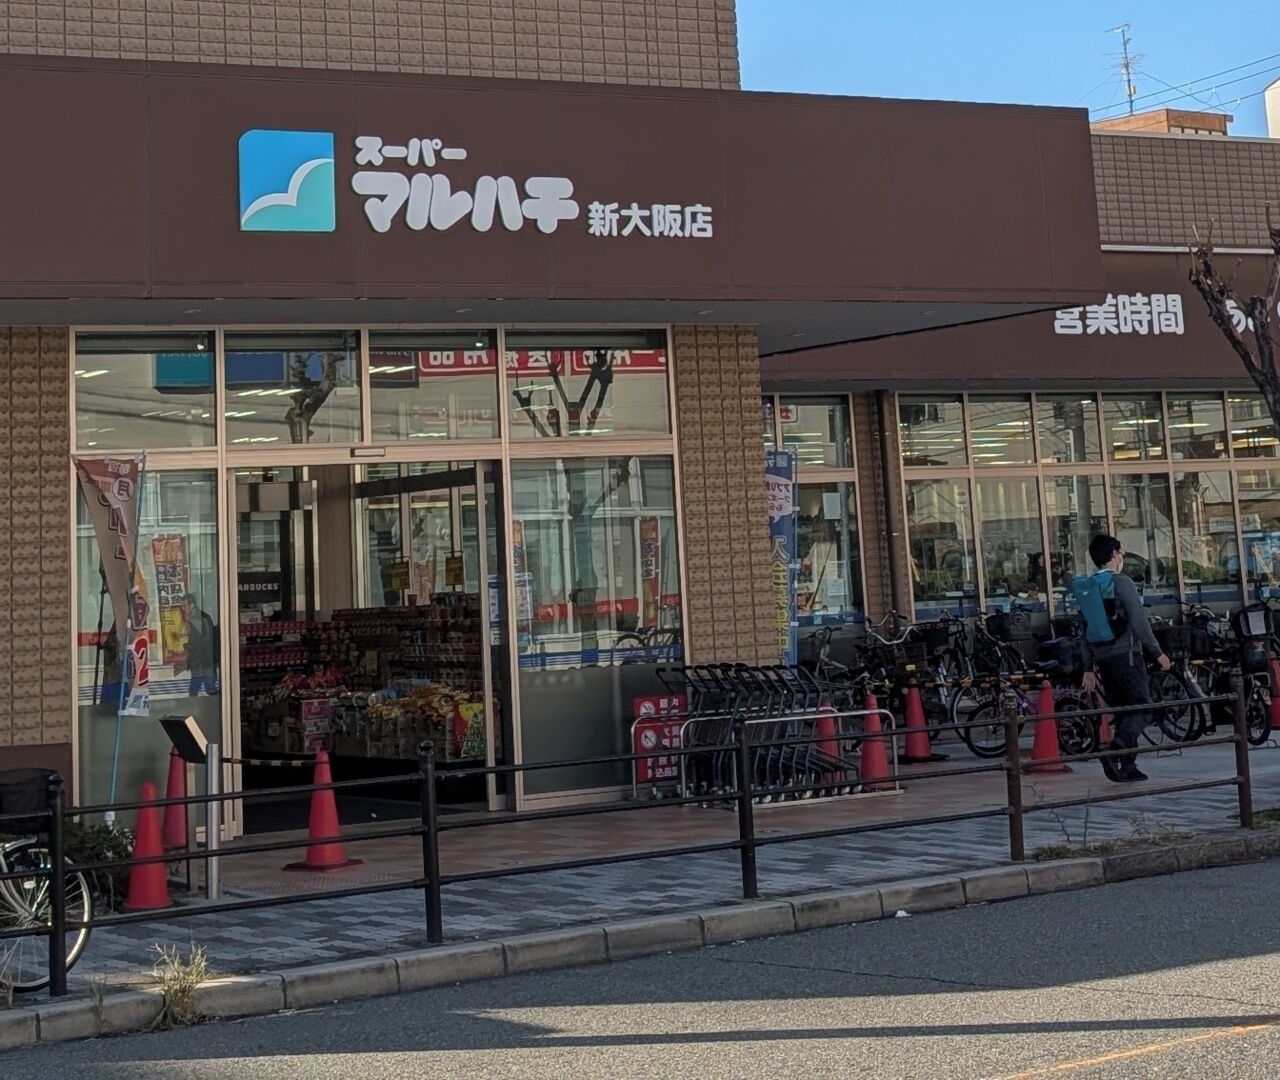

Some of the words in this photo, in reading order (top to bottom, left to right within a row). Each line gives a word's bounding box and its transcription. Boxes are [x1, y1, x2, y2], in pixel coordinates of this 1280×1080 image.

[354, 136, 468, 167] スーパー
[351, 170, 580, 234] マルハチ
[587, 201, 714, 238] 新大阪店
[1054, 293, 1184, 335] 営業時間
[238, 583, 279, 591] ARBUCKS
